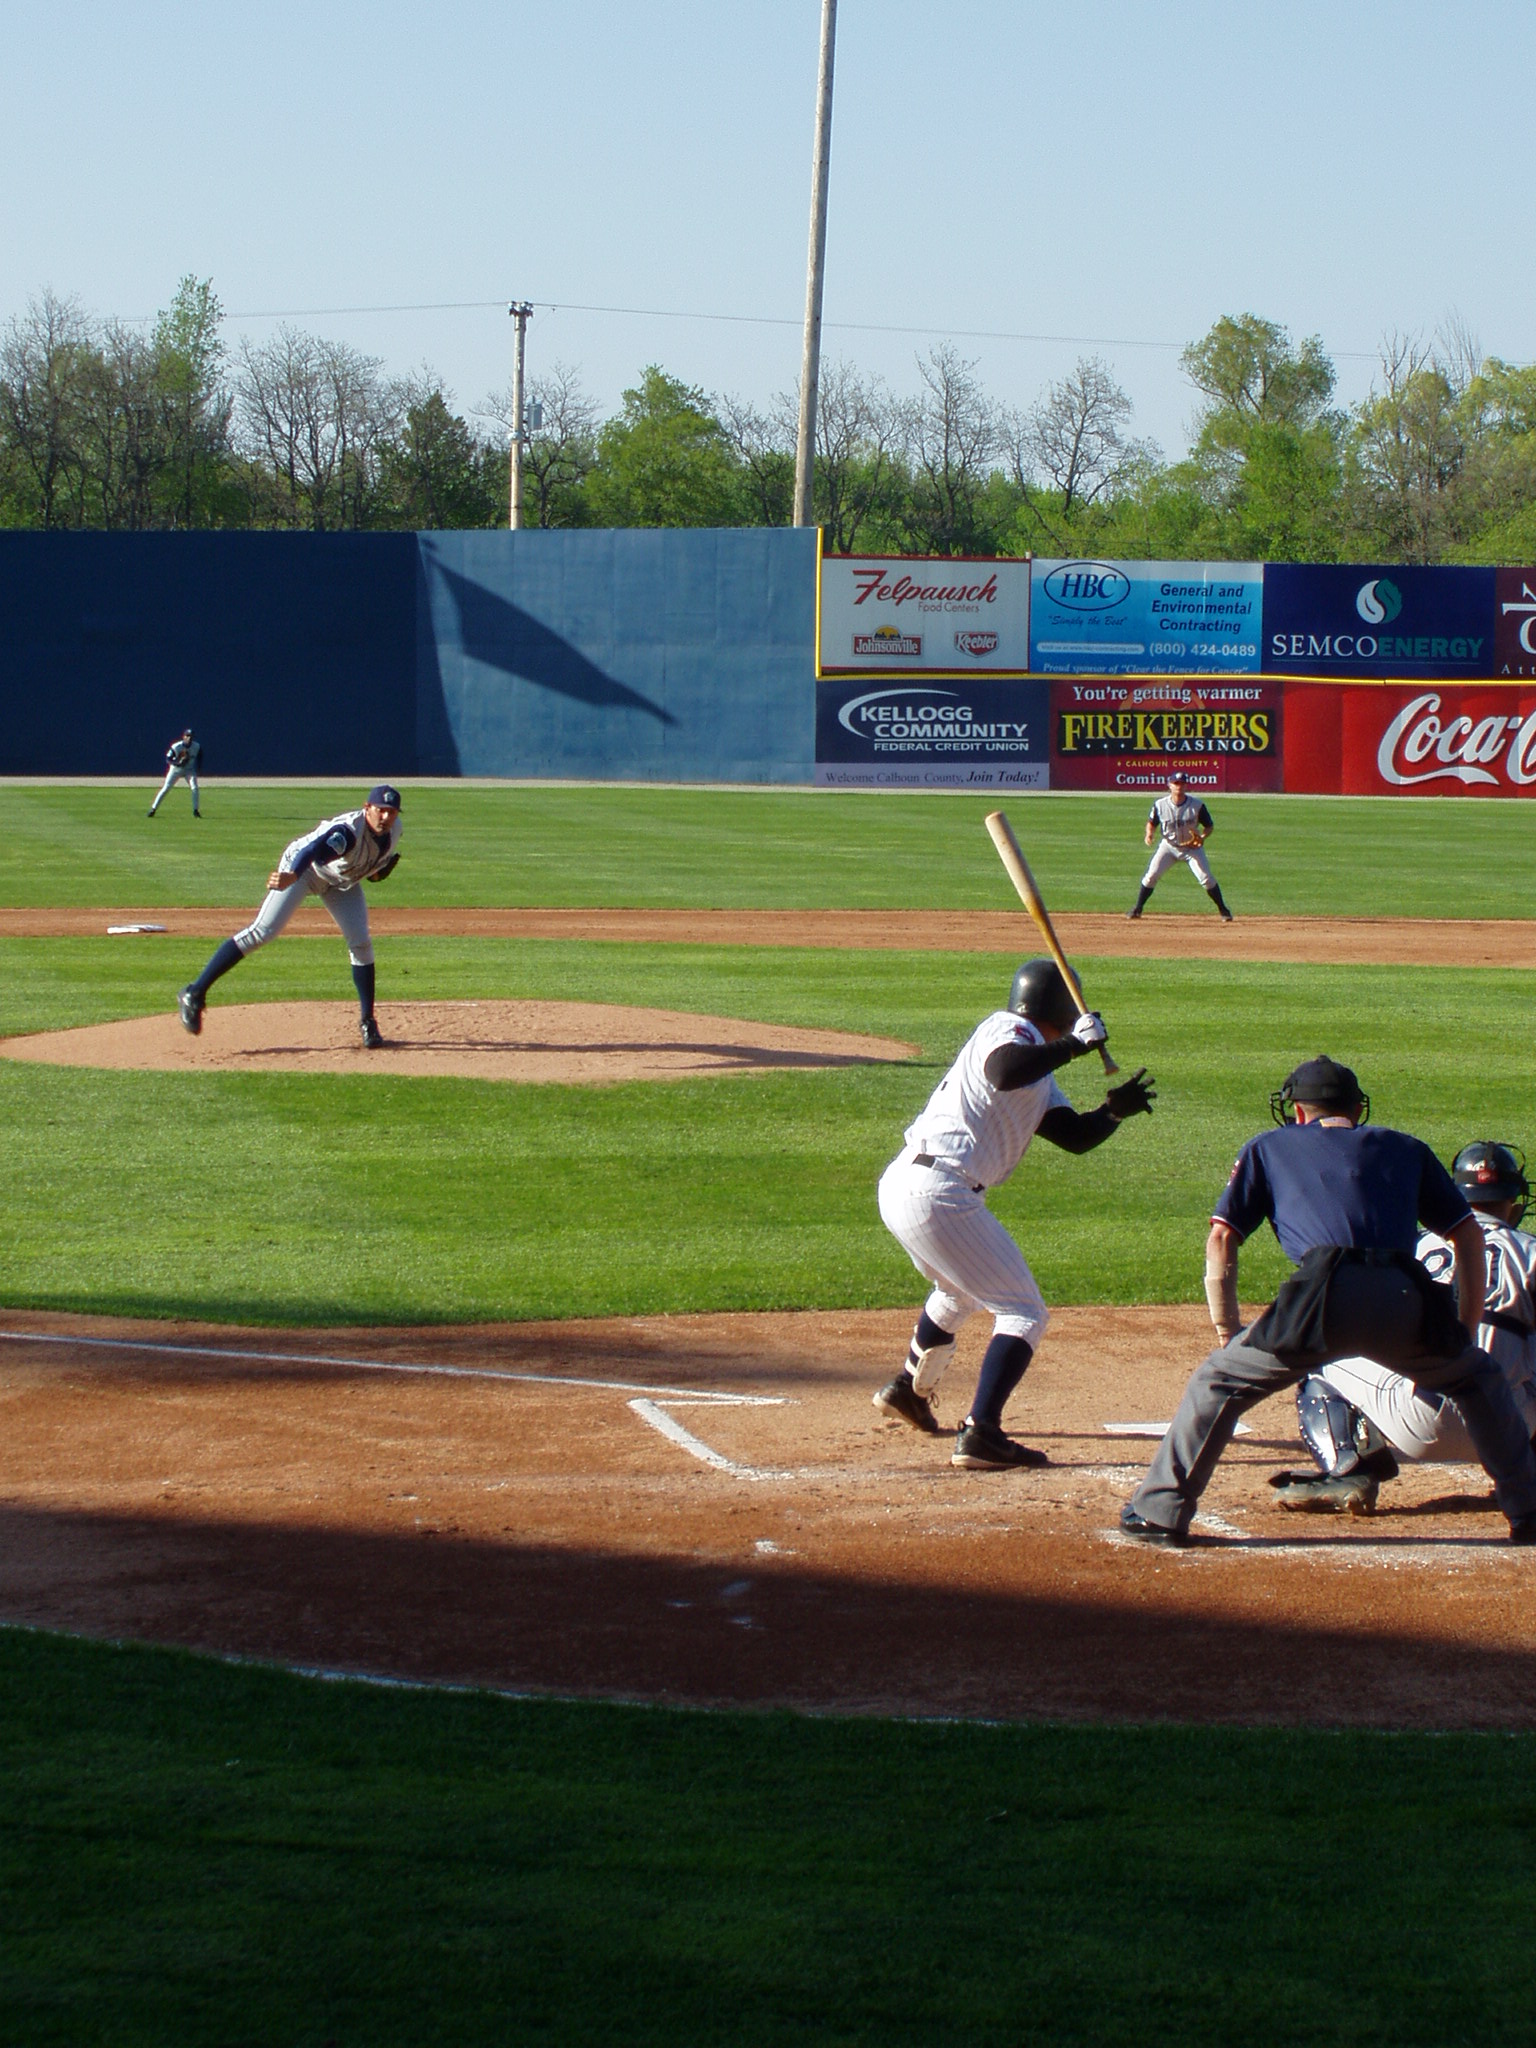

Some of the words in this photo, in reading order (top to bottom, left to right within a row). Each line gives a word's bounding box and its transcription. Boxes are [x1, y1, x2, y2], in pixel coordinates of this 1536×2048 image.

[853, 570, 997, 606] Felpausch
[1061, 573, 1117, 599] HBC
[1160, 583, 1213, 597] General
[1219, 584, 1244, 598] and
[918, 602, 942, 612] Food
[944, 603, 980, 613] Centers
[1152, 600, 1252, 615] Environmental
[1159, 618, 1241, 635] Contracting
[856, 638, 918, 654] Johnsonville
[956, 634, 997, 653] Keebler
[1149, 642, 1186, 657] (800)
[1191, 644, 1256, 657] 424-0489
[1073, 686, 1128, 701] You're
[1133, 686, 1192, 703] getting
[1197, 688, 1262, 700] warmer
[860, 706, 973, 722] KELLOGG
[874, 723, 1028, 738] COMMUNITY
[874, 742, 932, 751] FEDERAL
[935, 742, 982, 751] CREDIT
[986, 742, 1029, 751] UNION
[1165, 739, 1246, 752] CASINO
[1125, 760, 1168, 768] CALHOUN
[1172, 760, 1208, 768] COUNTY
[826, 772, 874, 783] Welcome
[877, 772, 919, 783] Calhoun
[924, 773, 964, 785] County,
[966, 771, 993, 783] Join
[998, 771, 1039, 785] Today!
[1116, 773, 1172, 785] Comin
